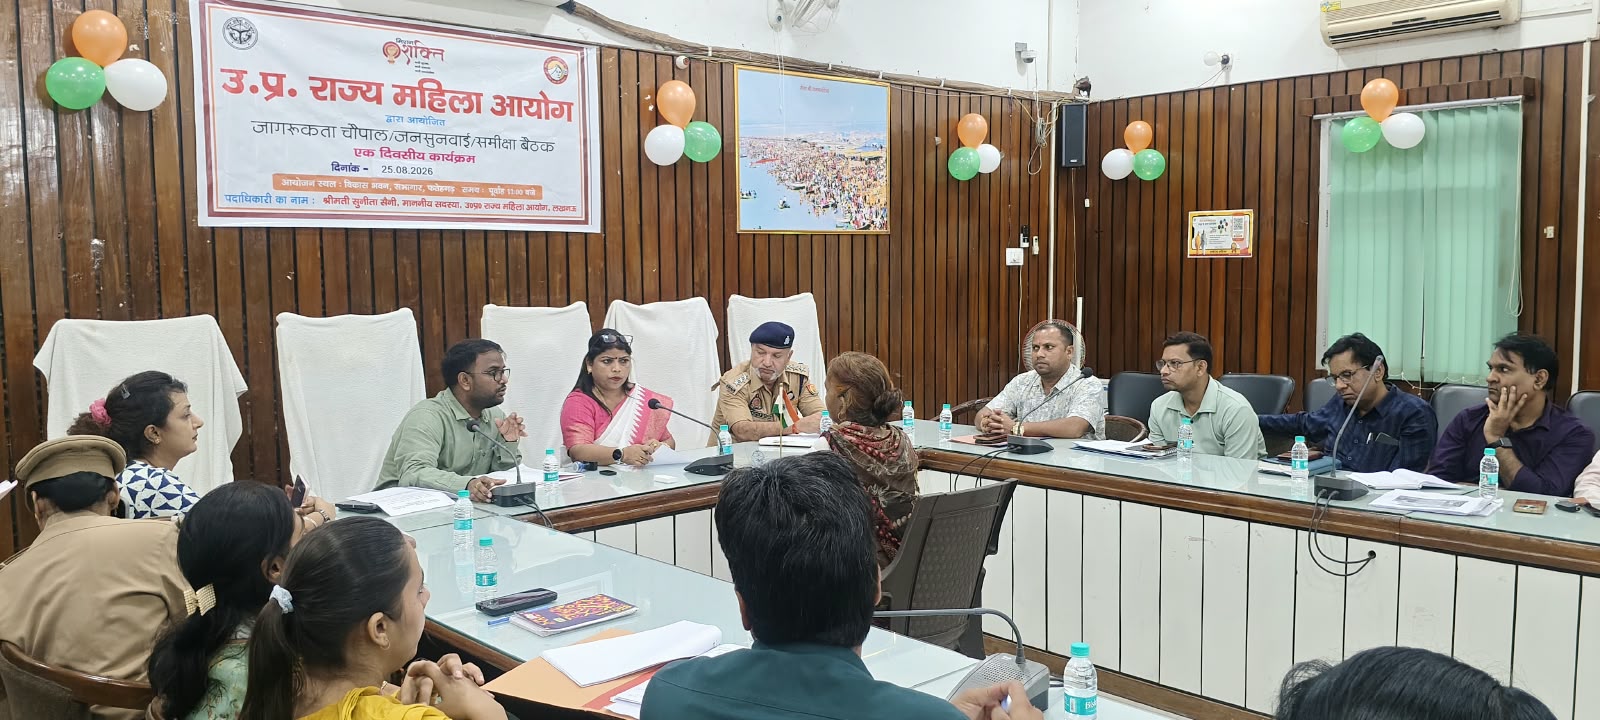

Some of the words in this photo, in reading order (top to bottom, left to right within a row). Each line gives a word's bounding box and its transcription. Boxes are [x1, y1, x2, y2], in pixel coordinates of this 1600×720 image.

[402, 40, 446, 65] शक्ति
[220, 68, 298, 101] उ.प्र.
[308, 76, 385, 105] राज्य
[391, 78, 483, 114] महिला
[490, 90, 574, 122] आयोग
[385, 115, 404, 124] द्वारा
[407, 115, 446, 126] आयोजित
[250, 121, 337, 138] जागरूकता
[520, 136, 556, 152] बैठक
[353, 148, 376, 158] एक
[380, 146, 426, 161] दिवसीय
[429, 150, 476, 164] कार्यक्रम
[331, 161, 361, 173] दिनांक
[381, 165, 434, 176] 25.08.2026
[281, 177, 315, 188] आयोजन
[318, 180, 337, 188] स्थल
[344, 179, 369, 189] विकास
[224, 192, 272, 204] पदाधिकारी
[275, 195, 287, 204] का
[290, 196, 309, 205] नाम
[322, 194, 350, 206] श्रीमती
[352, 196, 378, 208] सुनीता
[402, 197, 433, 208] माननीय
[484, 202, 501, 210] राज्य
[502, 201, 525, 211] महिला
[552, 204, 577, 213] लखनऊ
